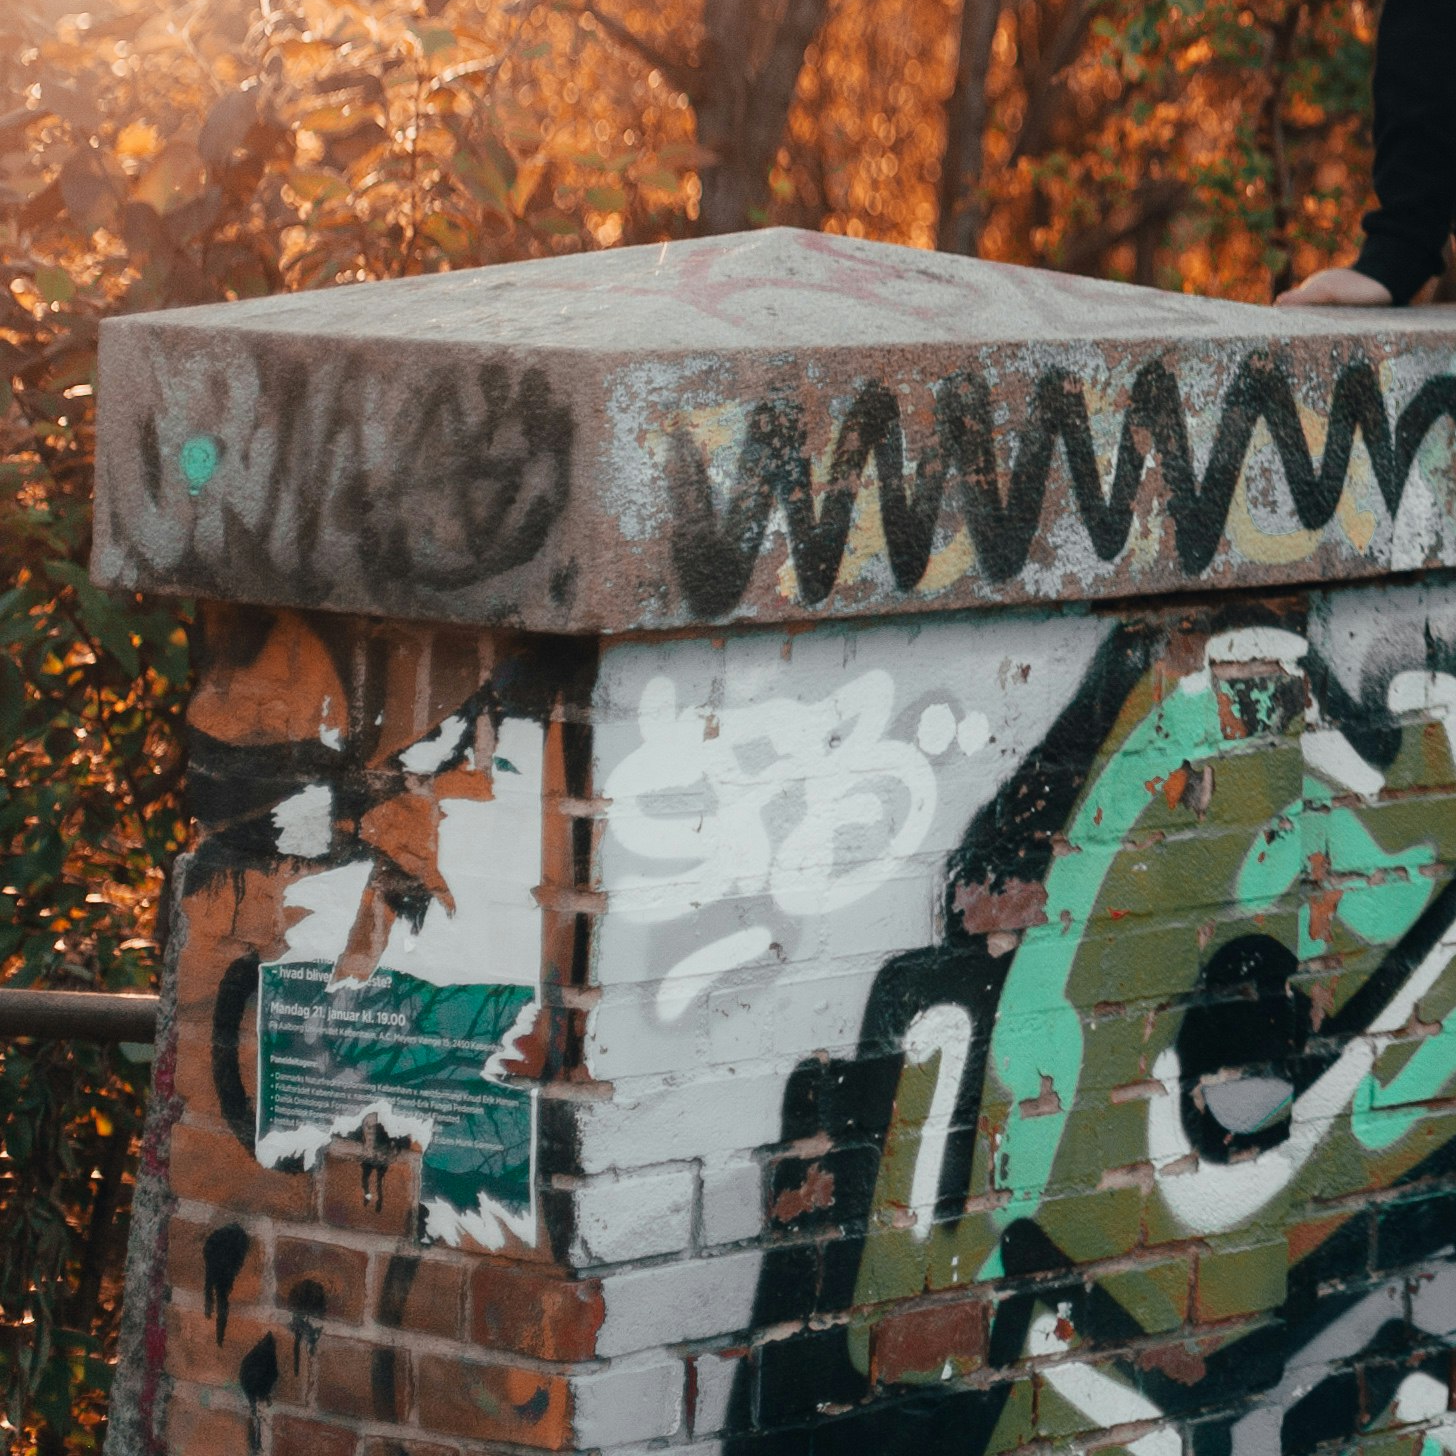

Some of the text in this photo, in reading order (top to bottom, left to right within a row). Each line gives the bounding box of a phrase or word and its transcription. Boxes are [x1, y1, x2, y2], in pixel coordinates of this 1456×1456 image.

[280, 966, 304, 980] hvad
[270, 1001, 406, 1026] Mandag 21. januar kl. 19.00
